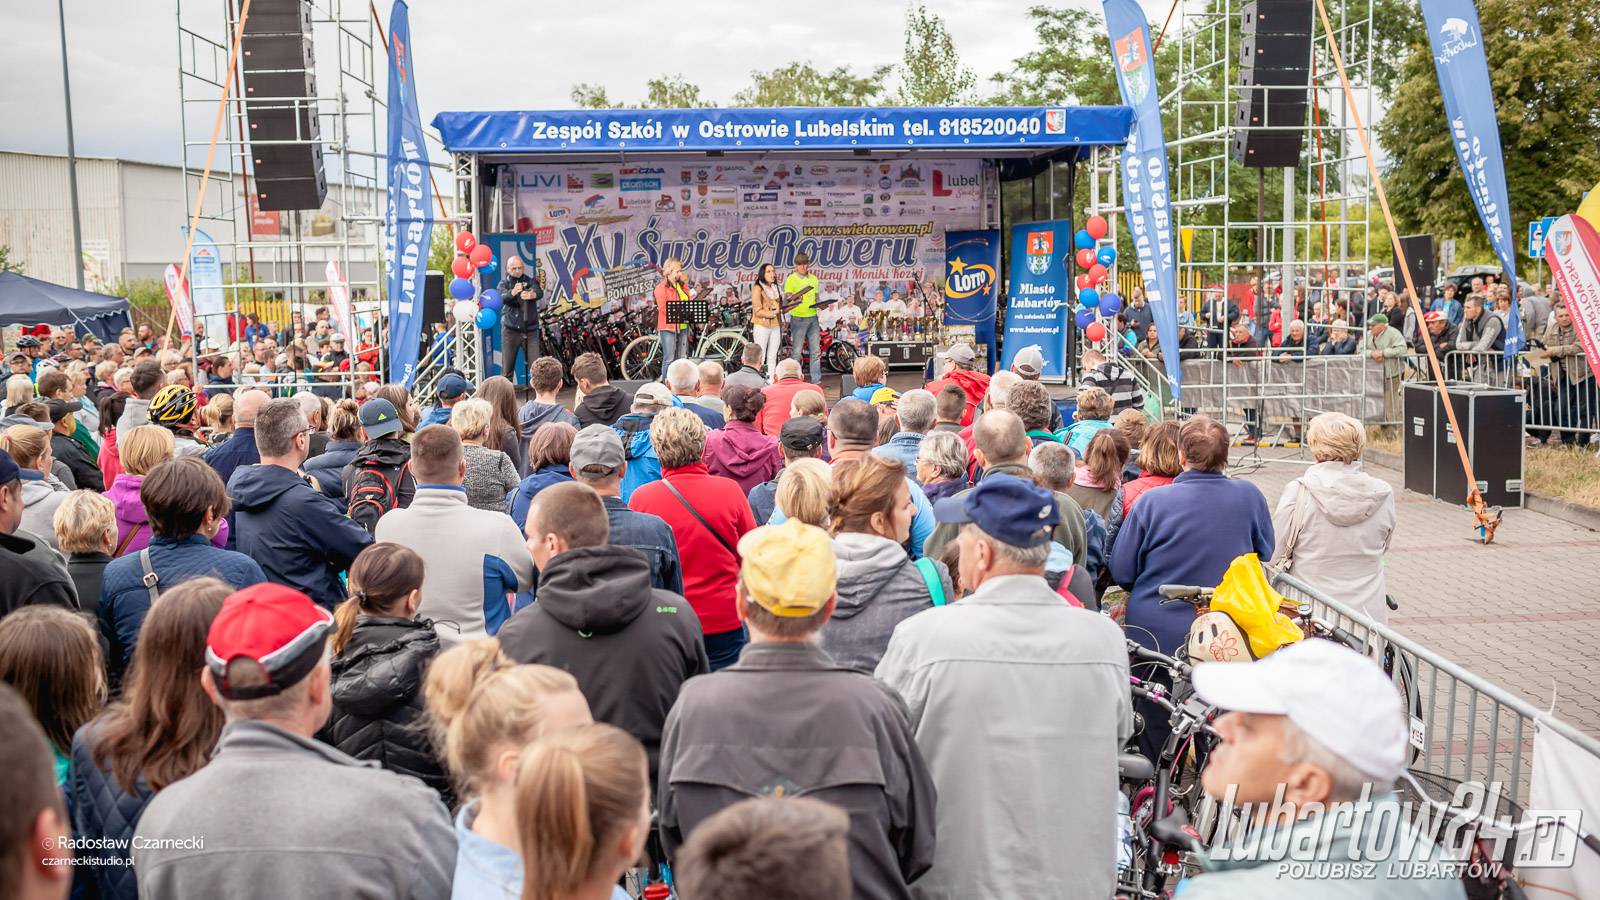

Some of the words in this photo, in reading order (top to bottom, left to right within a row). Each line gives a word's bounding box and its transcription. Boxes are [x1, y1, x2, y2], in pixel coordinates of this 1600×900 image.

[533, 120, 602, 143] Zespół
[607, 119, 662, 140] Szkół
[672, 125, 690, 138] w
[699, 119, 789, 139] Ostrowie
[794, 118, 895, 138] Lubelskim
[902, 117, 935, 137] tel.
[939, 116, 1041, 137] 818520040
[549, 209, 566, 218] LOTTO
[398, 136, 425, 317] Lubartów
[802, 221, 934, 237] www.swietoroweru.pl
[632, 217, 765, 279] Święto
[768, 224, 918, 267] Roweru
[546, 222, 625, 305] XXV
[852, 267, 889, 280] Moniki
[954, 270, 986, 292] LOTTO
[607, 279, 655, 302] POMOŻESZ
[1019, 283, 1055, 295] Miasto
[1010, 296, 1061, 309] Lubartów
[1009, 325, 1059, 335] www.lubartow.pl
